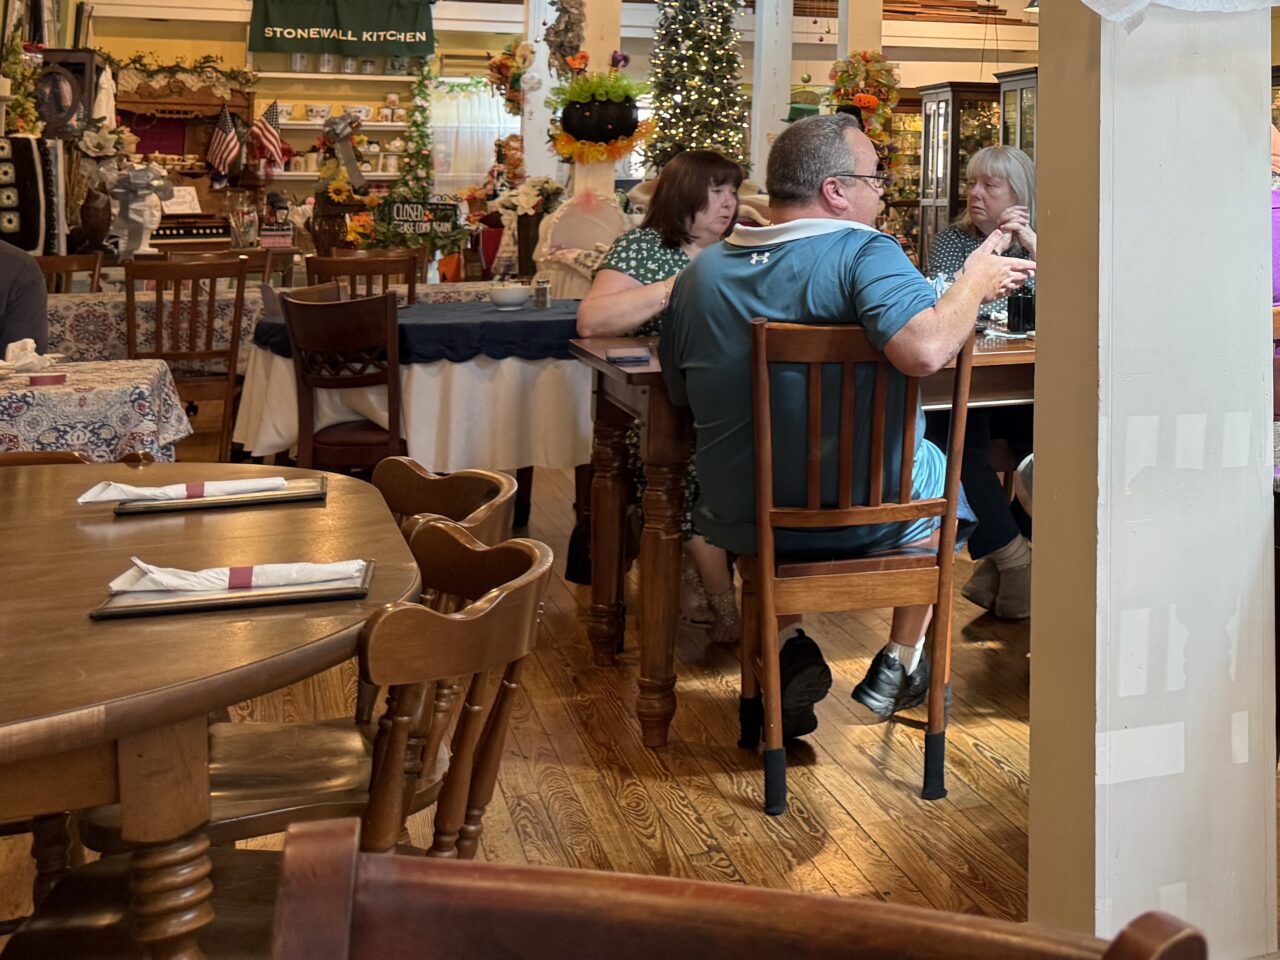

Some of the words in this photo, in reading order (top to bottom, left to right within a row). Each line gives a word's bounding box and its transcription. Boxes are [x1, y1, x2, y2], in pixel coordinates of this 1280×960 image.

[264, 27, 357, 41] STONEWALL
[362, 30, 427, 42] KITCHEN
[393, 203, 424, 221] CLOSED
